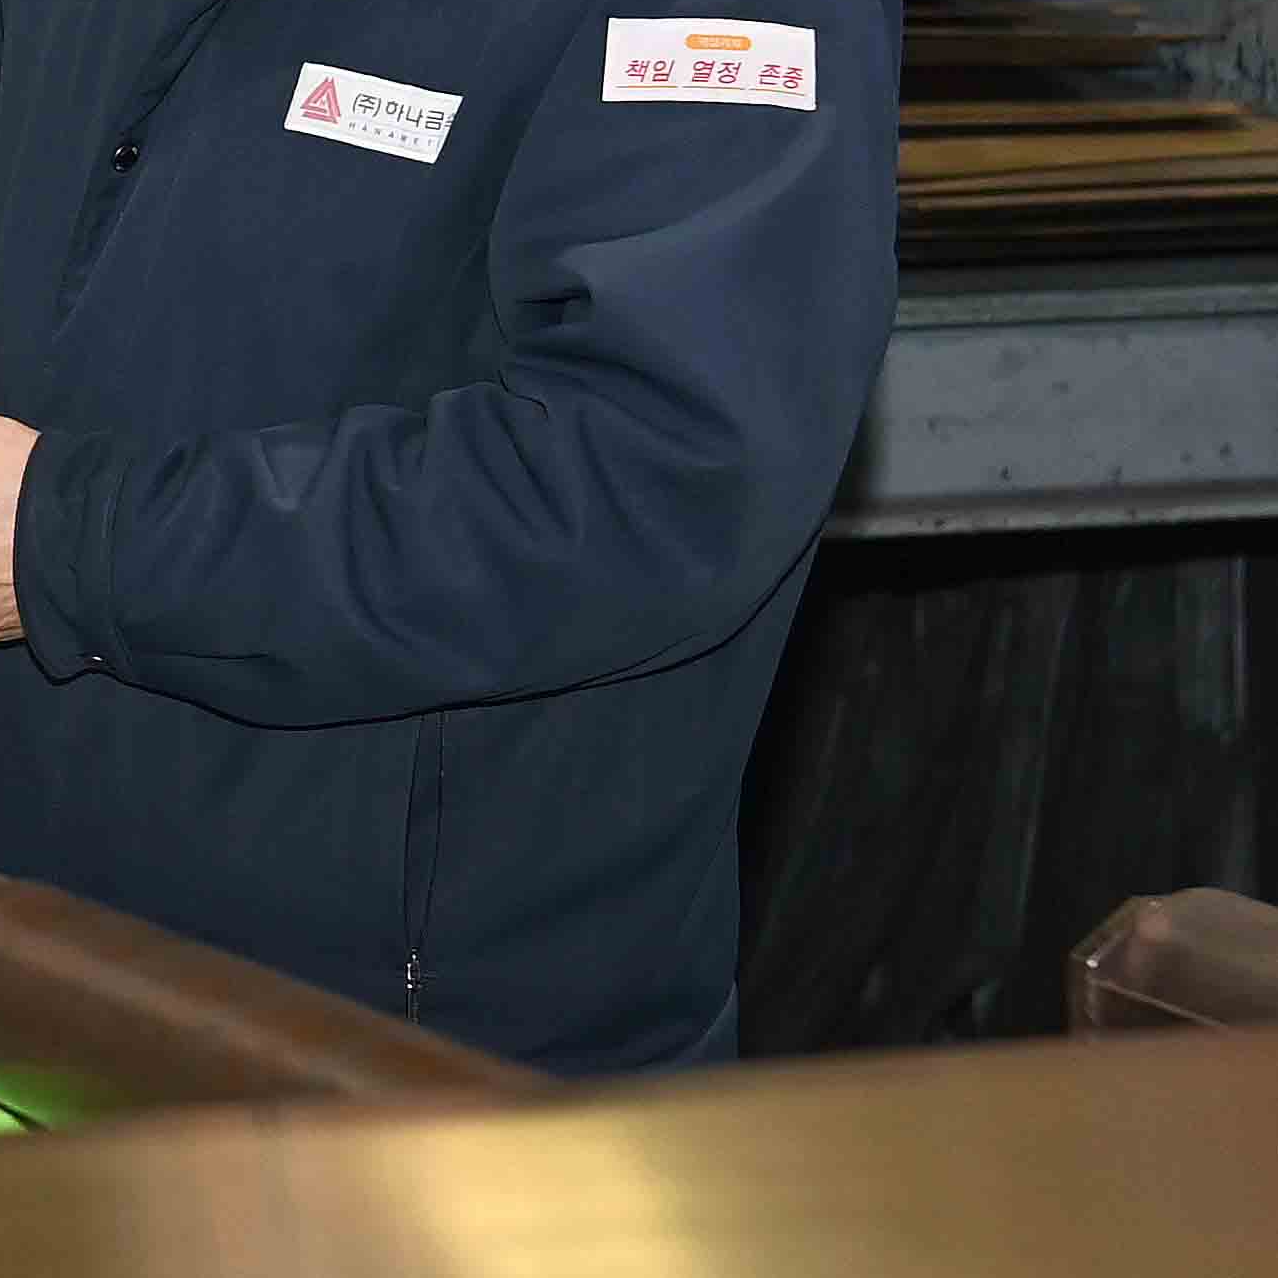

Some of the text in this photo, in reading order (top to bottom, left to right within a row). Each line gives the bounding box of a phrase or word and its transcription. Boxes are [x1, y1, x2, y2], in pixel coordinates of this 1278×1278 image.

[624, 59, 804, 89] 책임 열정 존중
